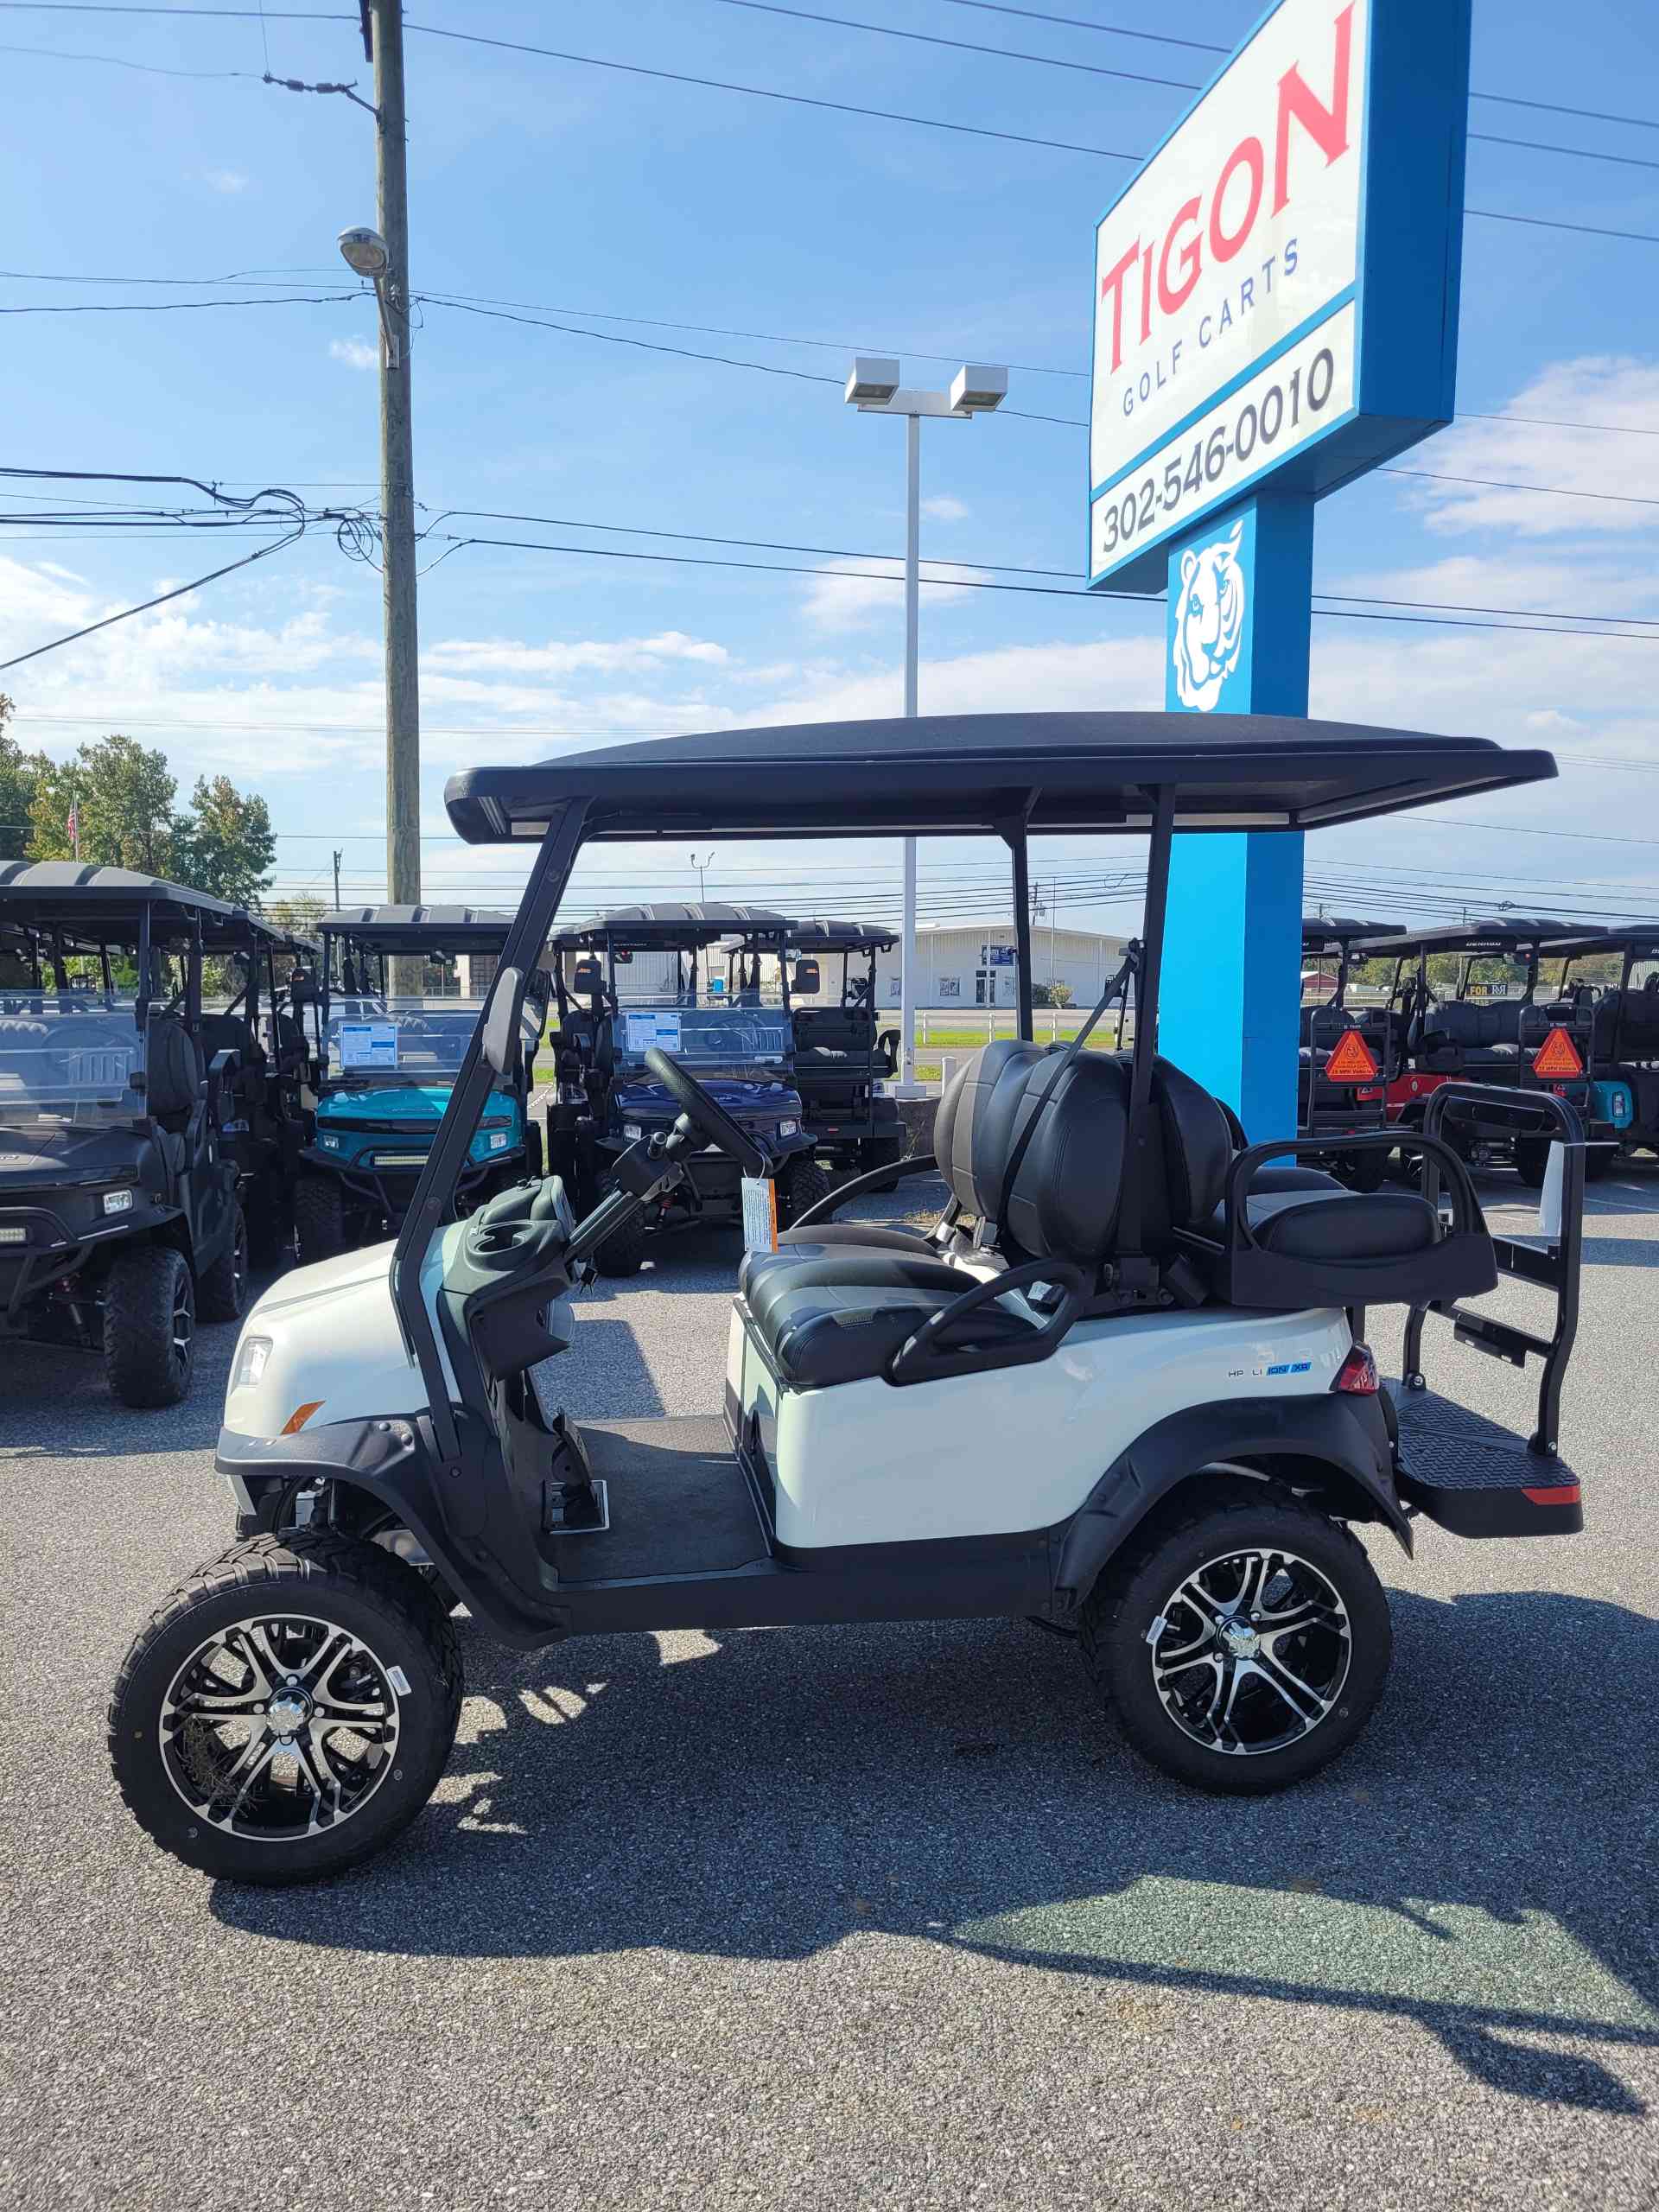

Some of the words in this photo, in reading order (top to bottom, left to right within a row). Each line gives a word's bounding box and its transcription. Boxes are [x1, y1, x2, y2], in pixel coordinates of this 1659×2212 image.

[1102, 2, 1356, 375] TIGON
[1123, 340, 1183, 416] GOLF
[1198, 238, 1298, 348] CARTS
[1103, 347, 1334, 552] 302-546-0010
[1470, 985, 1488, 996] FOR
